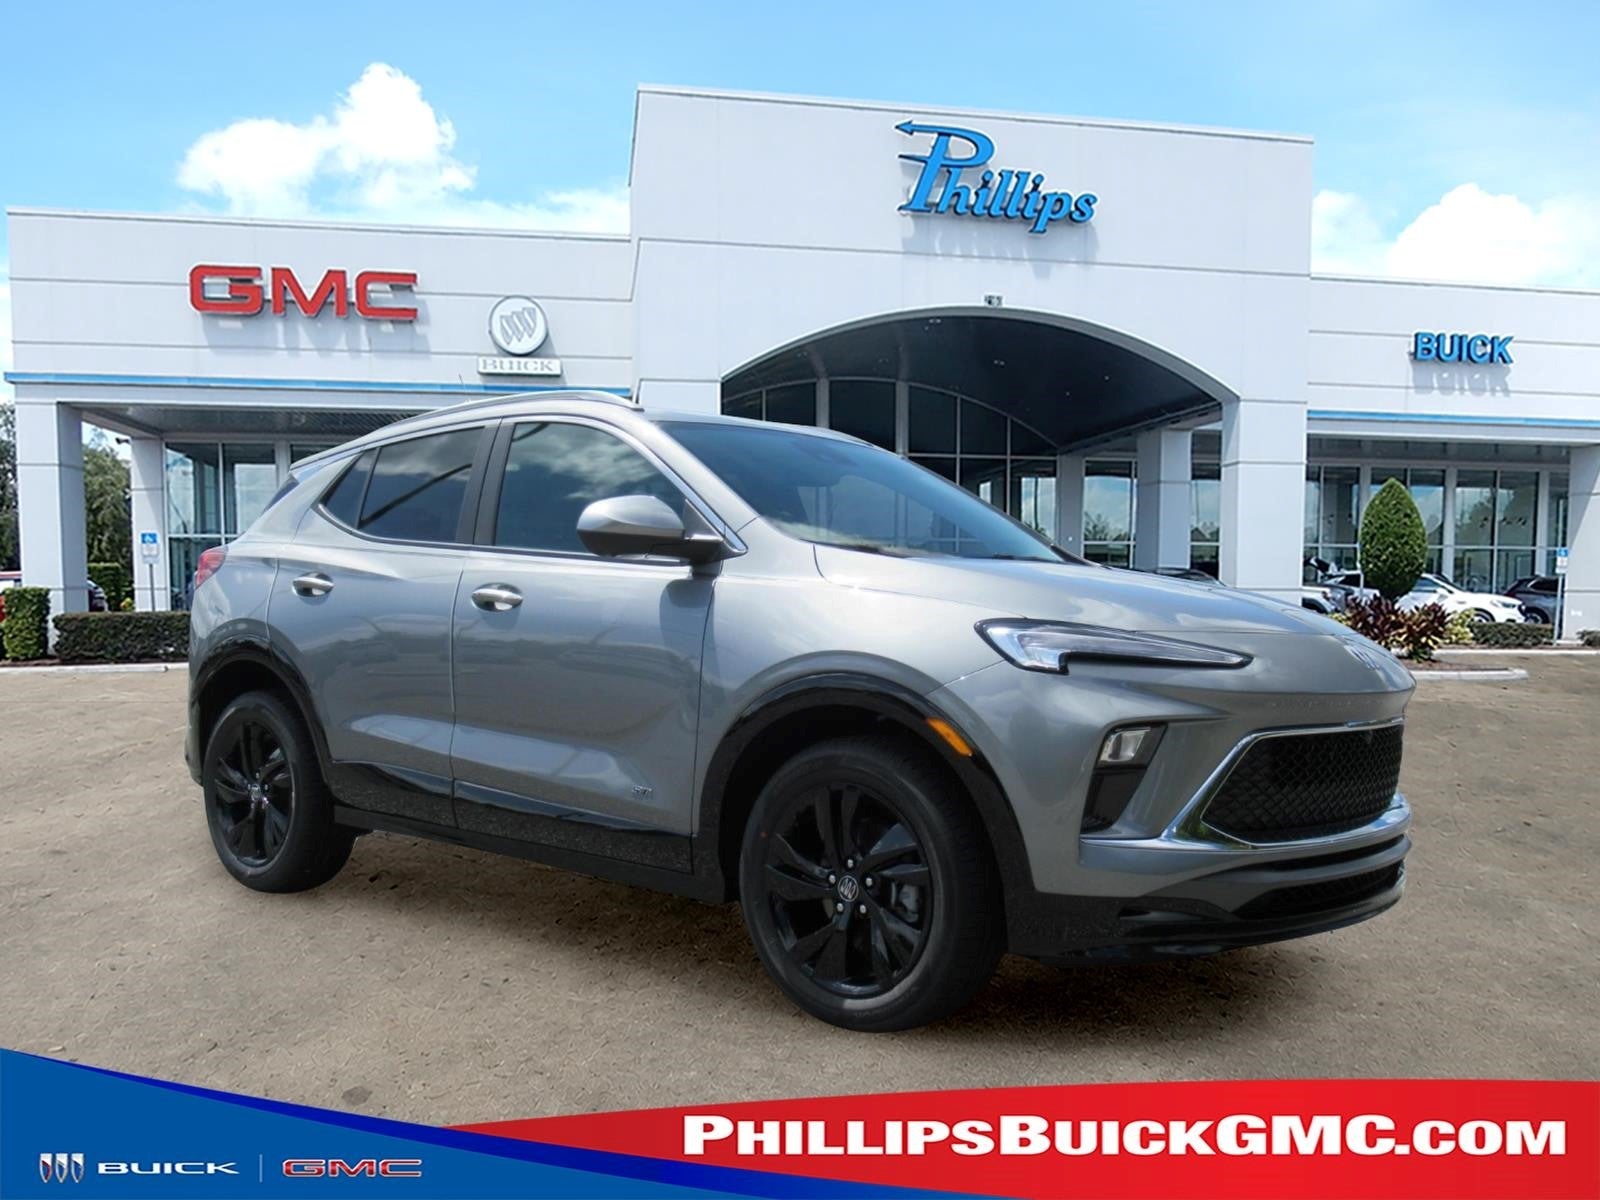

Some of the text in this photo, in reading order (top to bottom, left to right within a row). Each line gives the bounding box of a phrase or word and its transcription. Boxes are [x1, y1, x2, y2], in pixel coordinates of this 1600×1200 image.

[895, 121, 1098, 234] Phillips
[189, 264, 419, 321] GMC
[481, 358, 555, 372] BUICK
[1413, 331, 1514, 364] BUICK
